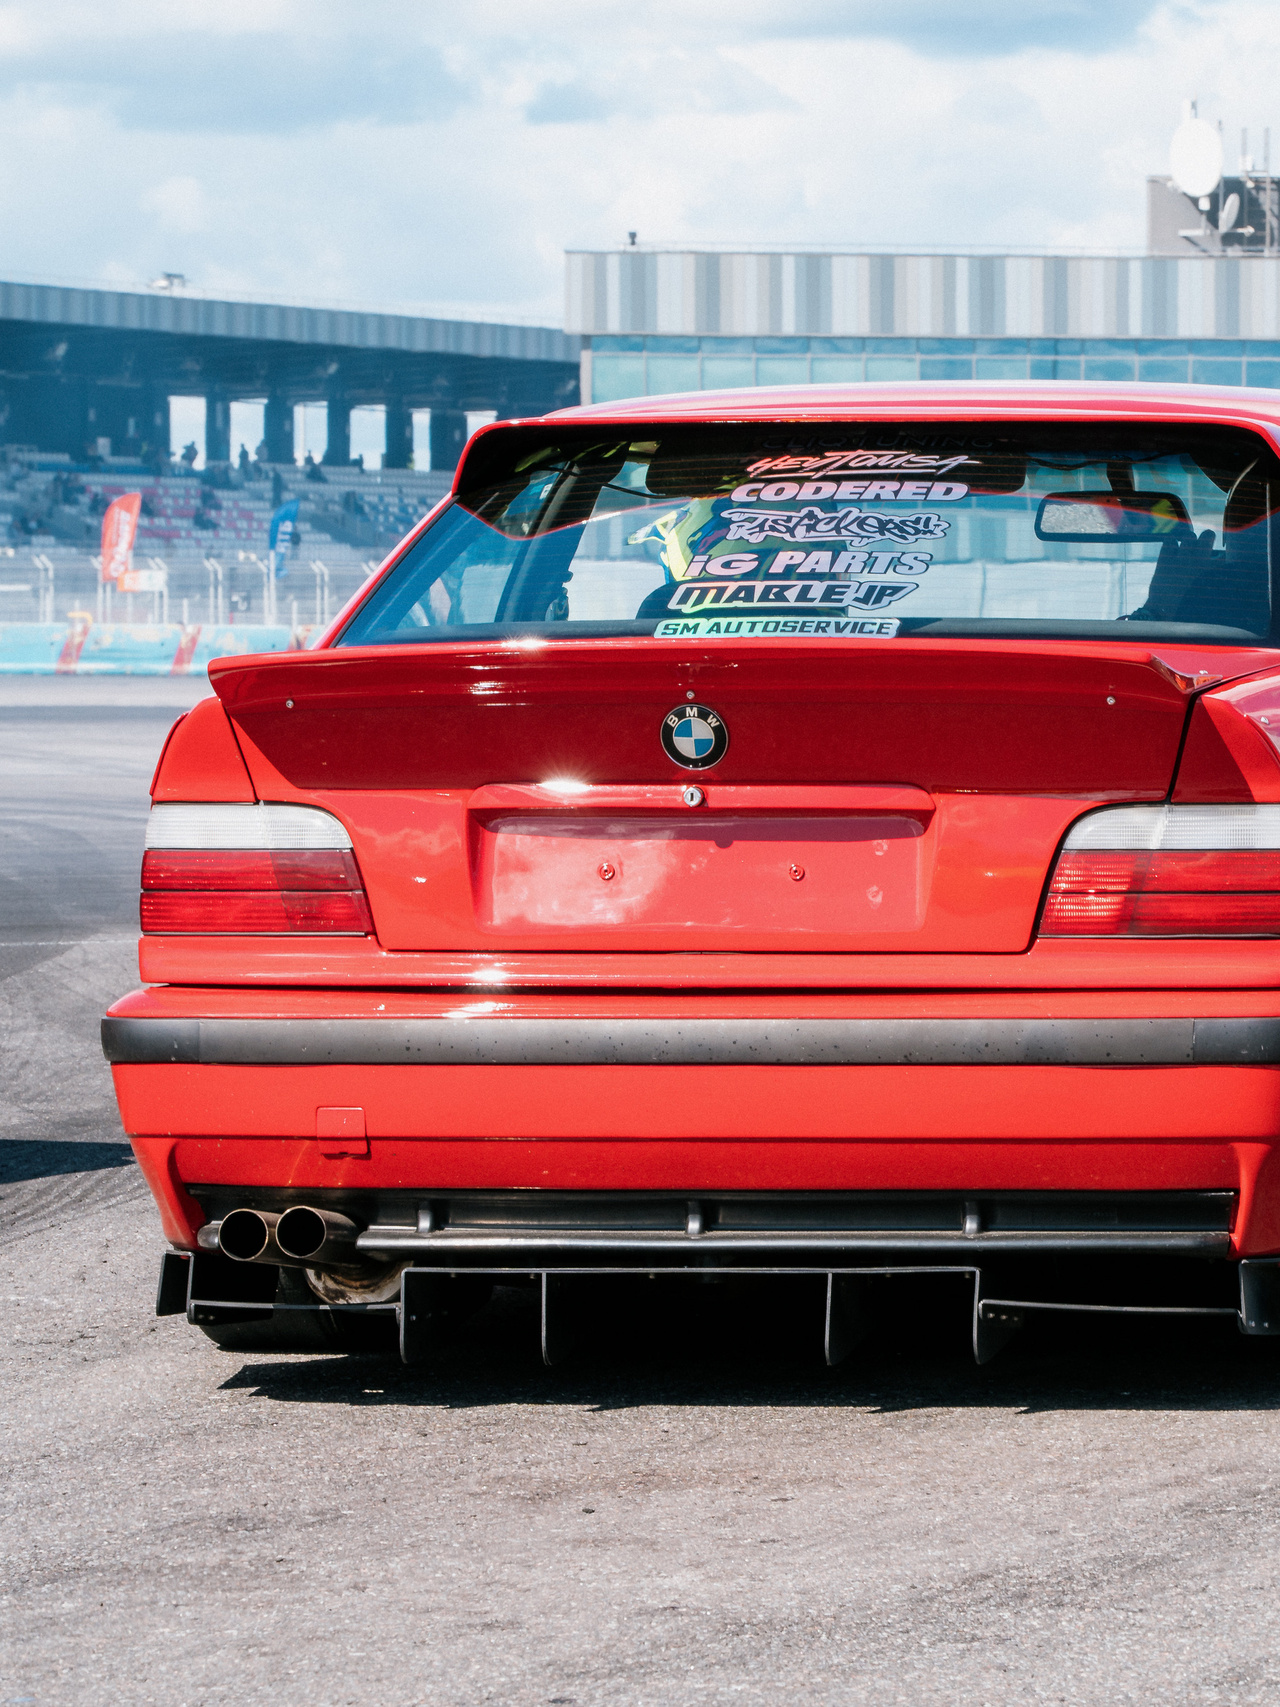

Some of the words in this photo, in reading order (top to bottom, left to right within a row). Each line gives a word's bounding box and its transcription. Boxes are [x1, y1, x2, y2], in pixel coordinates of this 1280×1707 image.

[731, 481, 970, 502] CODERED
[768, 551, 933, 575] PARTS
[660, 621, 701, 636] SM
[704, 620, 895, 636] AUTOSERVICE
[666, 706, 720, 728] BMW
